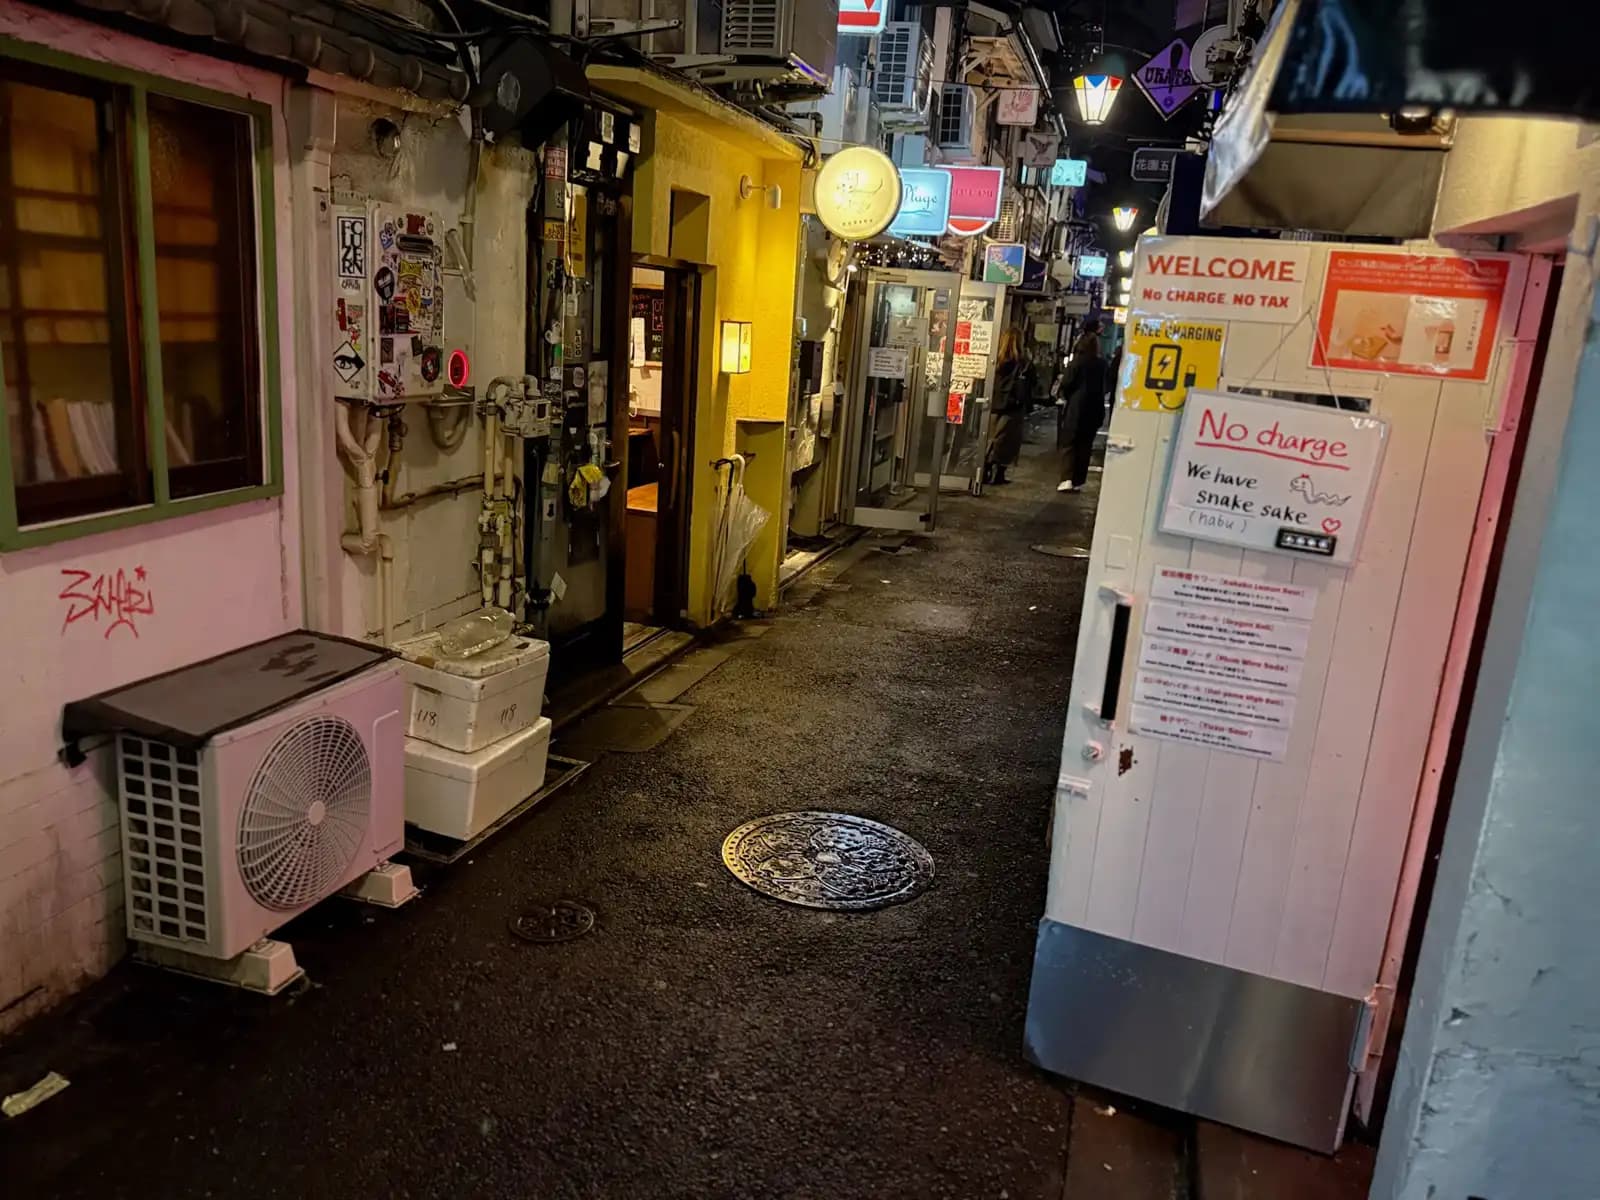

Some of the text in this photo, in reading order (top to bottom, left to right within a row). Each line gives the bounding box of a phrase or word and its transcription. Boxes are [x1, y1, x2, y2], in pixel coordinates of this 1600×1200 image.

[1147, 253, 1297, 281] WELCOME
[1142, 288, 1289, 310] No CHARGE NO TAX
[1134, 322, 1223, 343] FREE CHARGING
[1199, 408, 1349, 462] No charge
[1187, 460, 1258, 489] We have
[1196, 490, 1309, 526] snake sake
